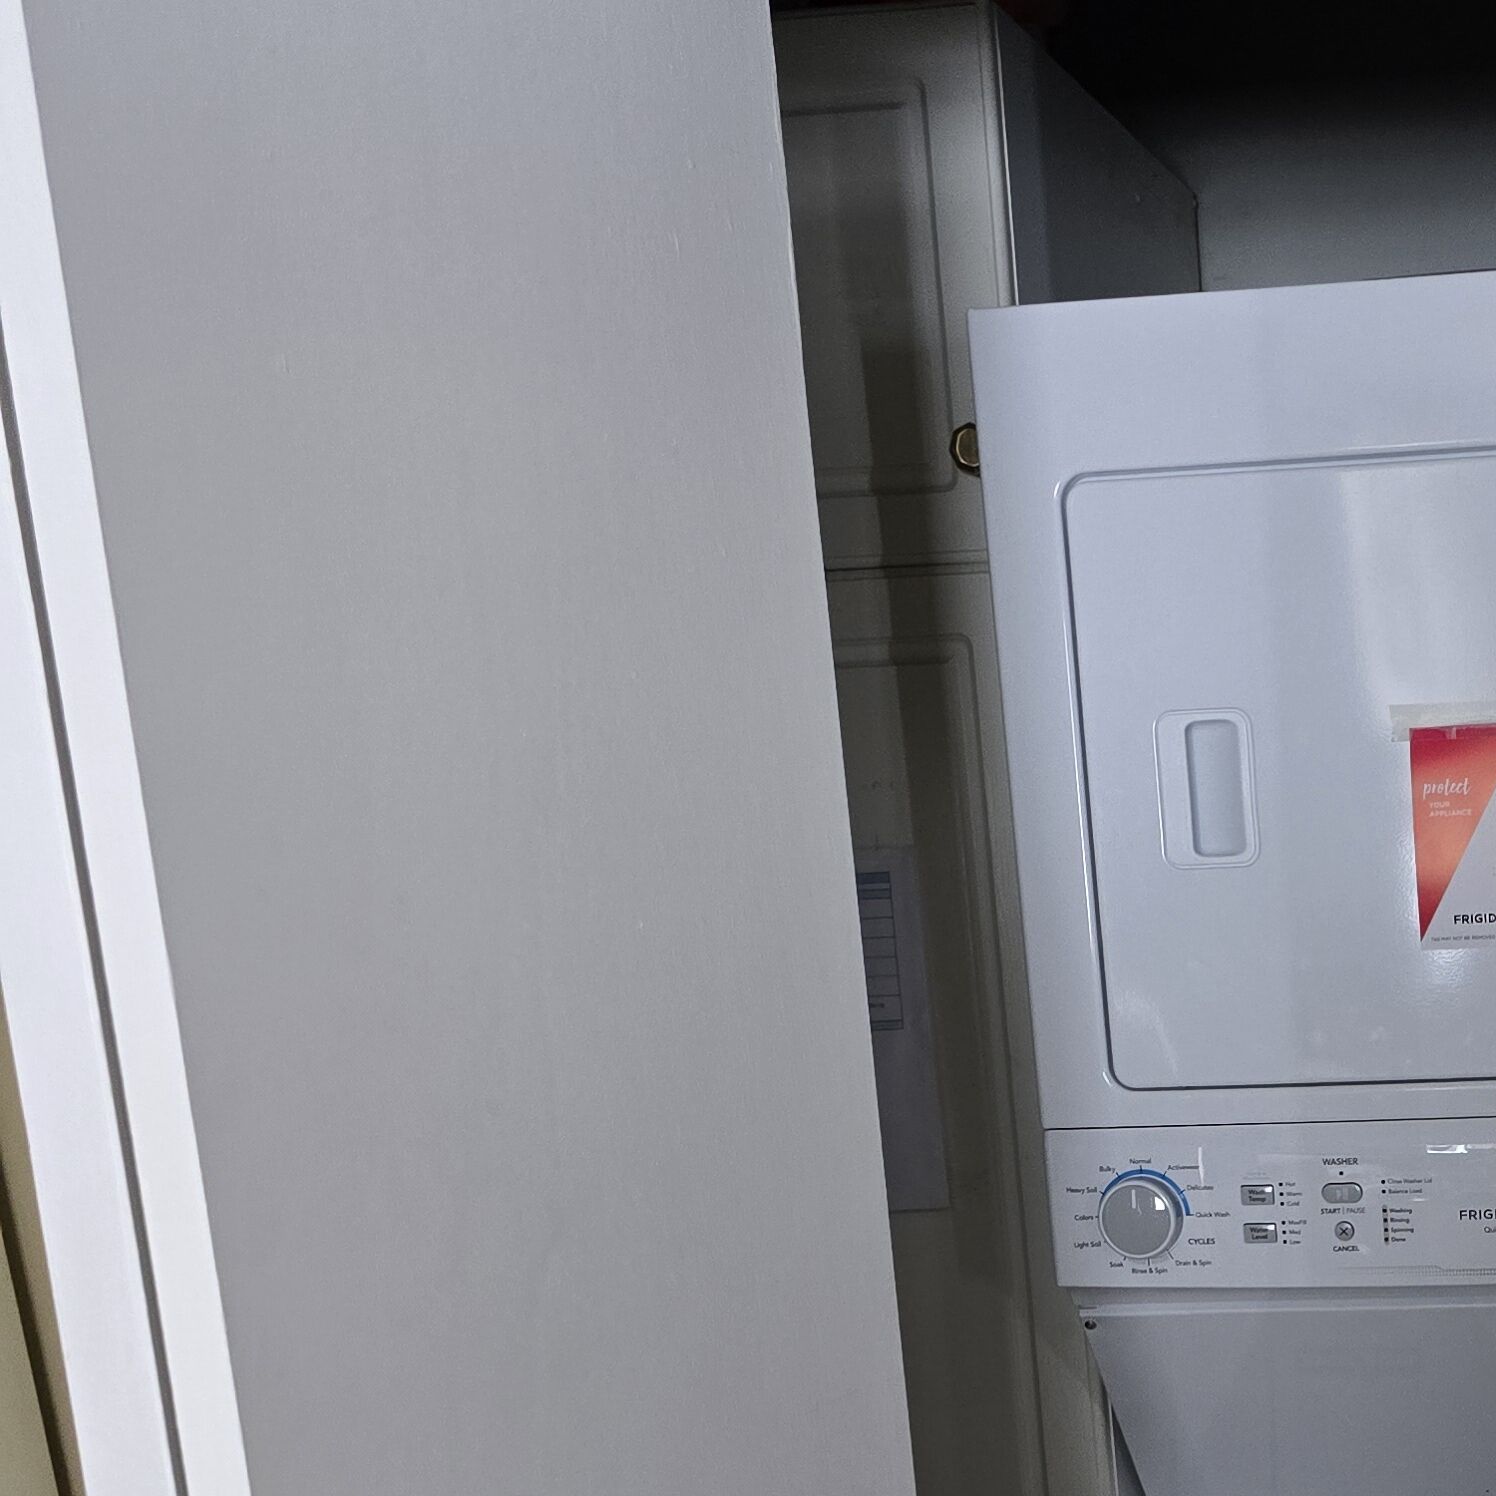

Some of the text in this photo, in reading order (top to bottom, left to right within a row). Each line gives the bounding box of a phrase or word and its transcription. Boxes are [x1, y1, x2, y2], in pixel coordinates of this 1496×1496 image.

[1422, 777, 1471, 799] protect
[1429, 801, 1450, 809] YOUR
[1429, 809, 1472, 817] APPLIANCE
[1129, 1157, 1152, 1165] Normal
[1322, 1157, 1359, 1166] WASHER
[1099, 1165, 1116, 1173] Bulky
[1320, 1207, 1341, 1215] START
[1188, 1238, 1216, 1246] CYCLES
[1333, 1245, 1360, 1253] CANCEL
[1199, 1259, 1212, 1267] Spin
[1155, 1267, 1168, 1275] Spin
